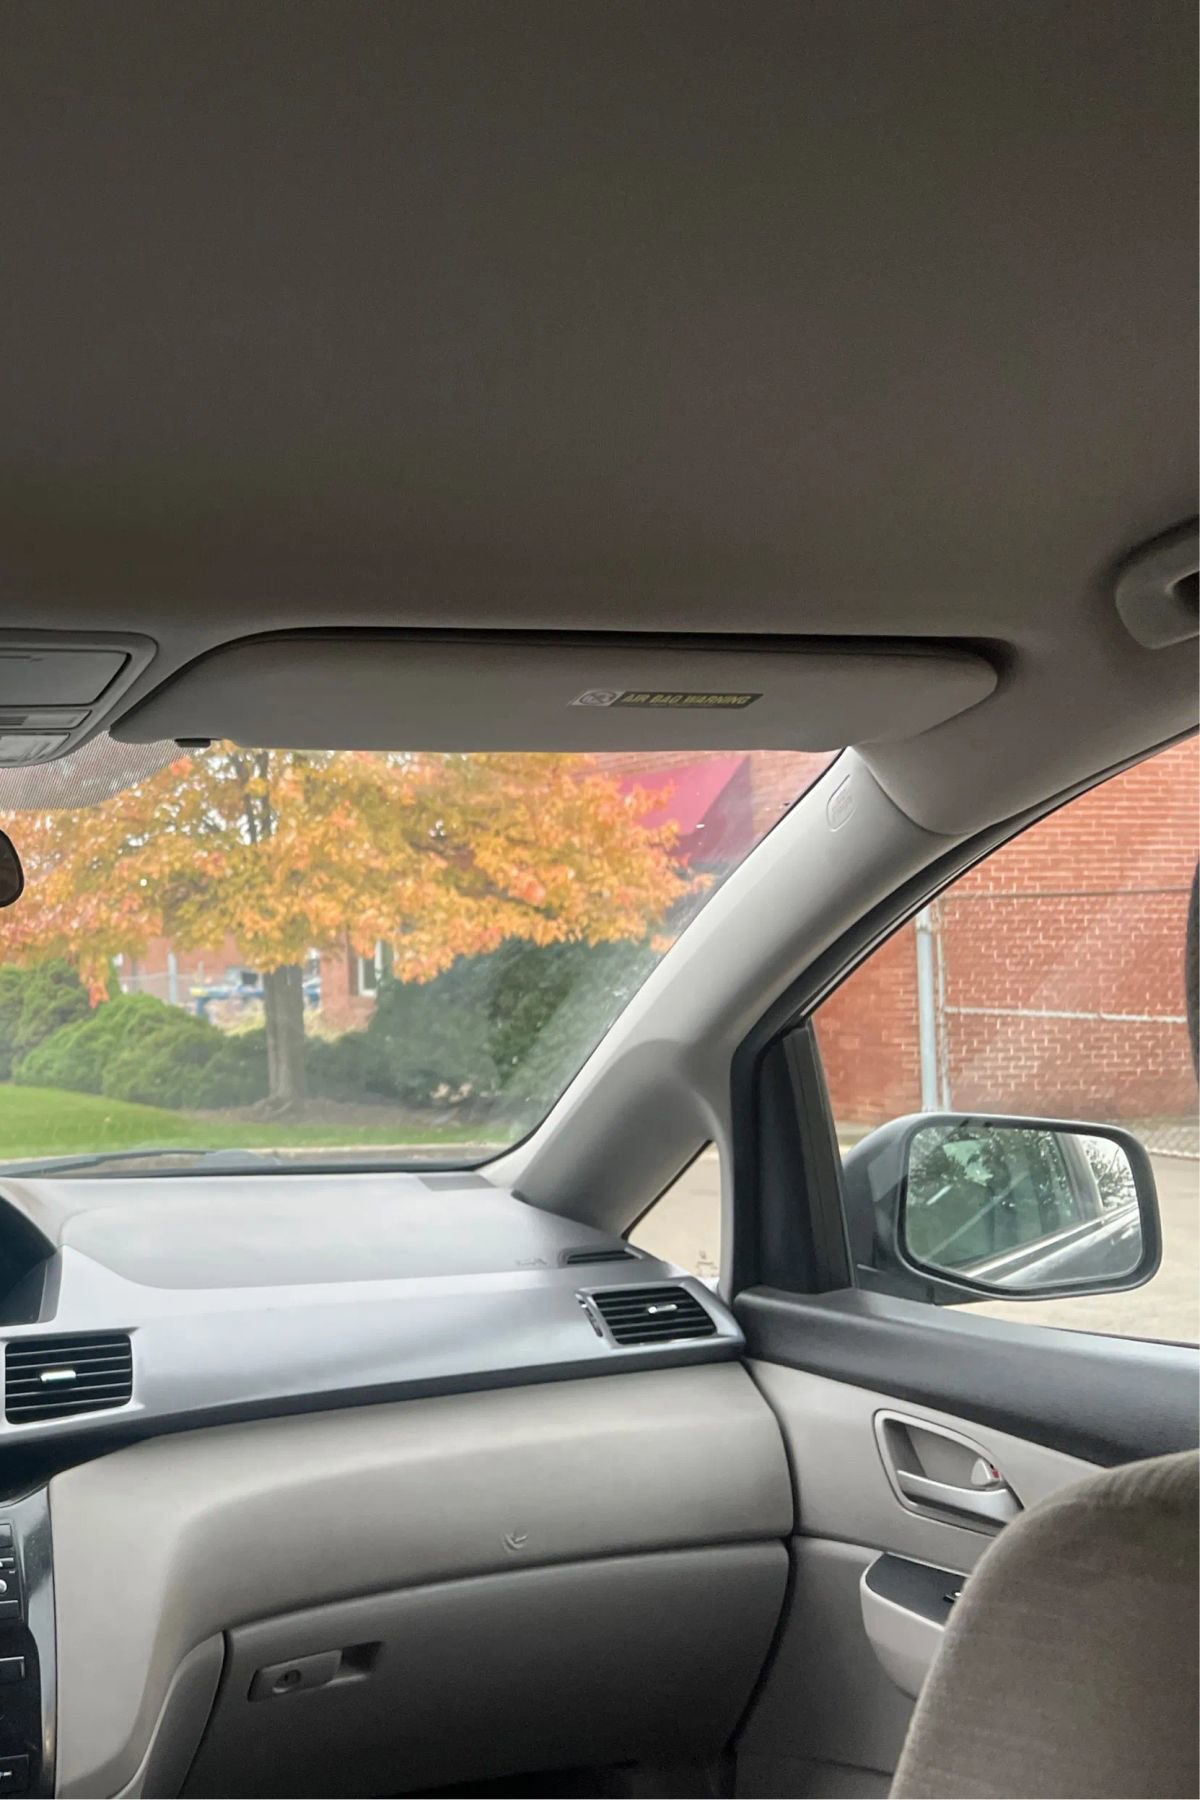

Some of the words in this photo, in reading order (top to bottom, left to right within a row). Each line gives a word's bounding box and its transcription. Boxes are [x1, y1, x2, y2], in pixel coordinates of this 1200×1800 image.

[621, 694, 649, 703] AIR
[650, 694, 681, 704] BAG
[683, 695, 752, 705] WARNING
